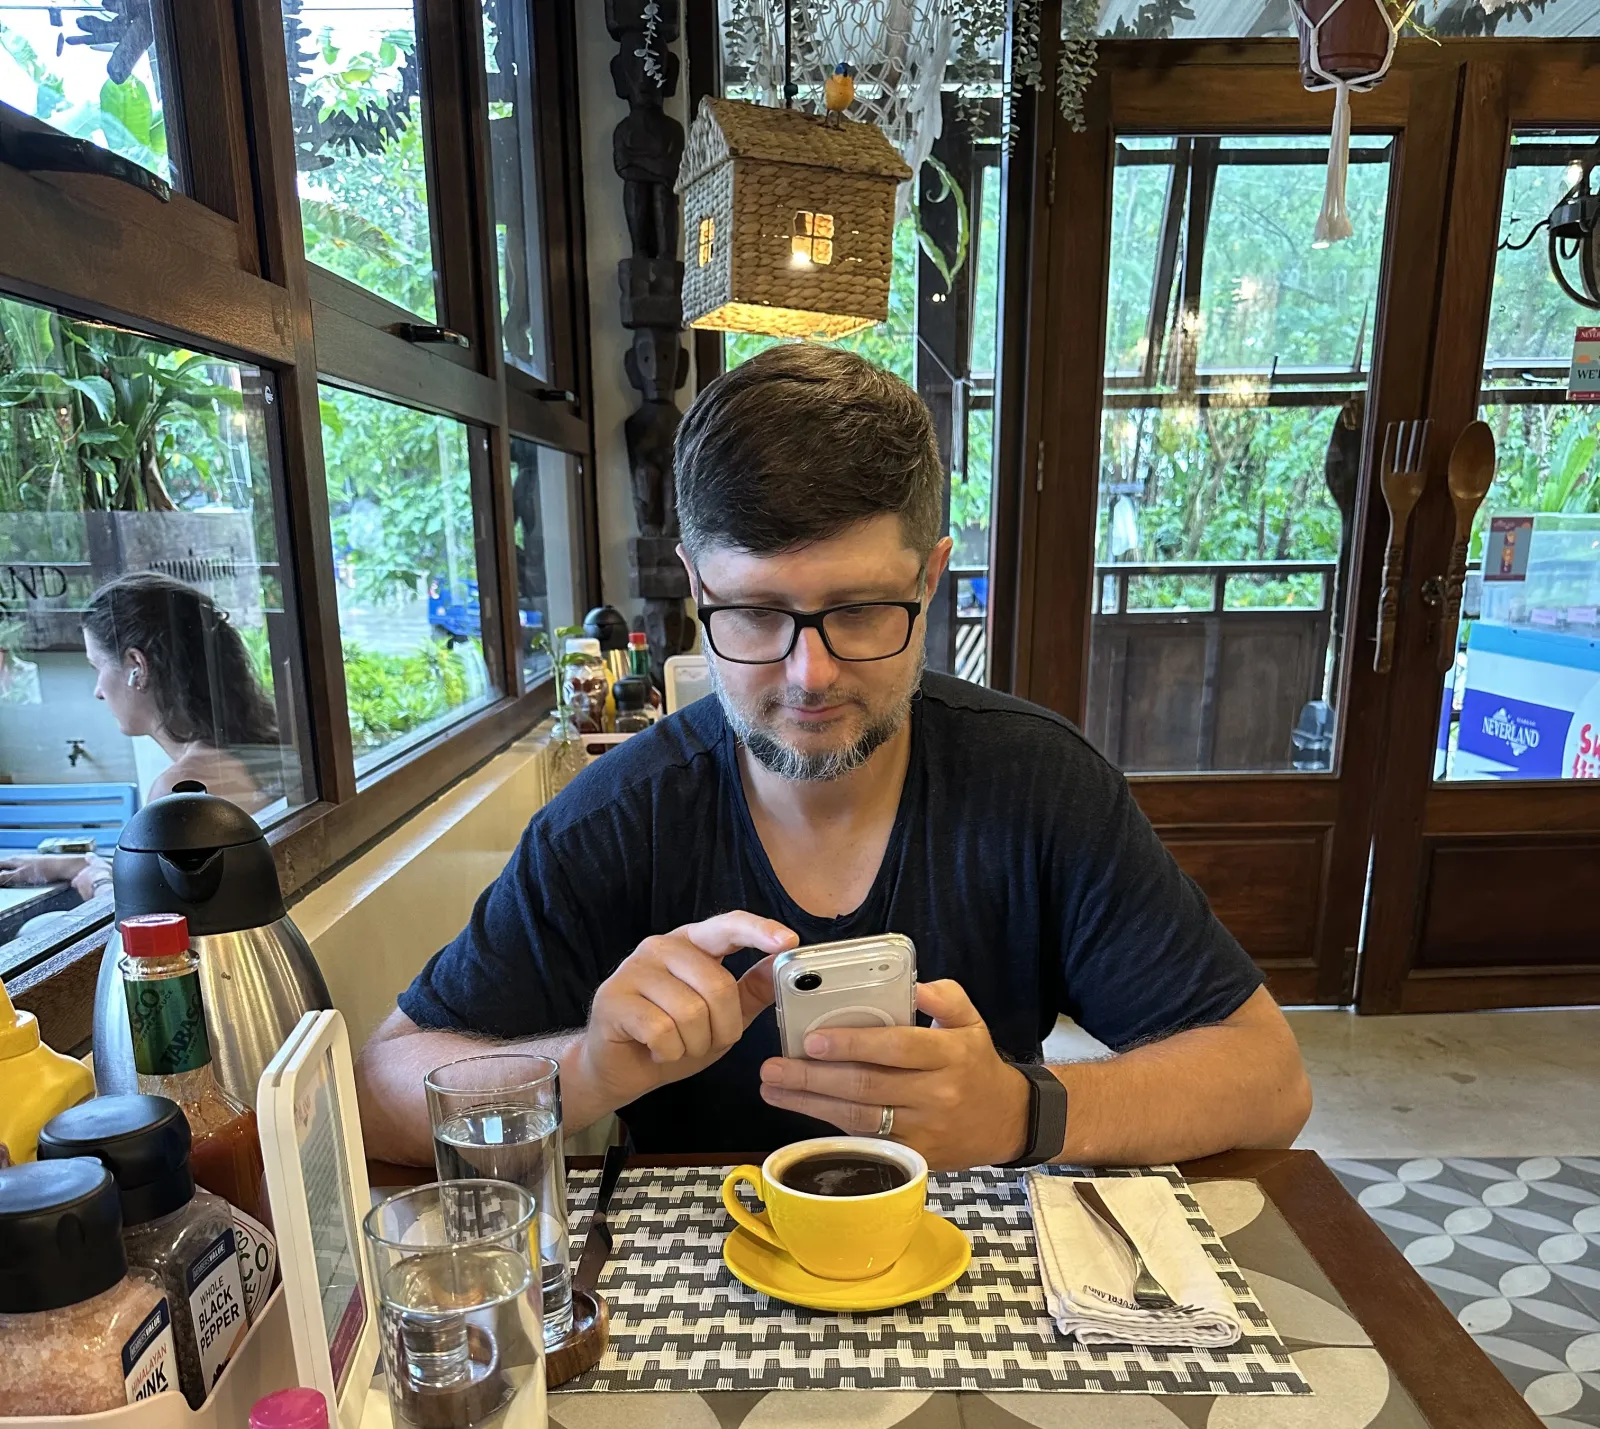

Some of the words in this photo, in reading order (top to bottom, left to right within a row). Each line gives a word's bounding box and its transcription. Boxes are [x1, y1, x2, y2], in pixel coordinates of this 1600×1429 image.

[0, 566, 67, 600] ND
[1482, 716, 1540, 748] NEVERLAND
[198, 1285, 234, 1332] BLACK
[200, 1275, 225, 1305] WHOLE
[200, 1303, 240, 1356] PEPPER
[131, 1342, 167, 1396] HIMALAYAN
